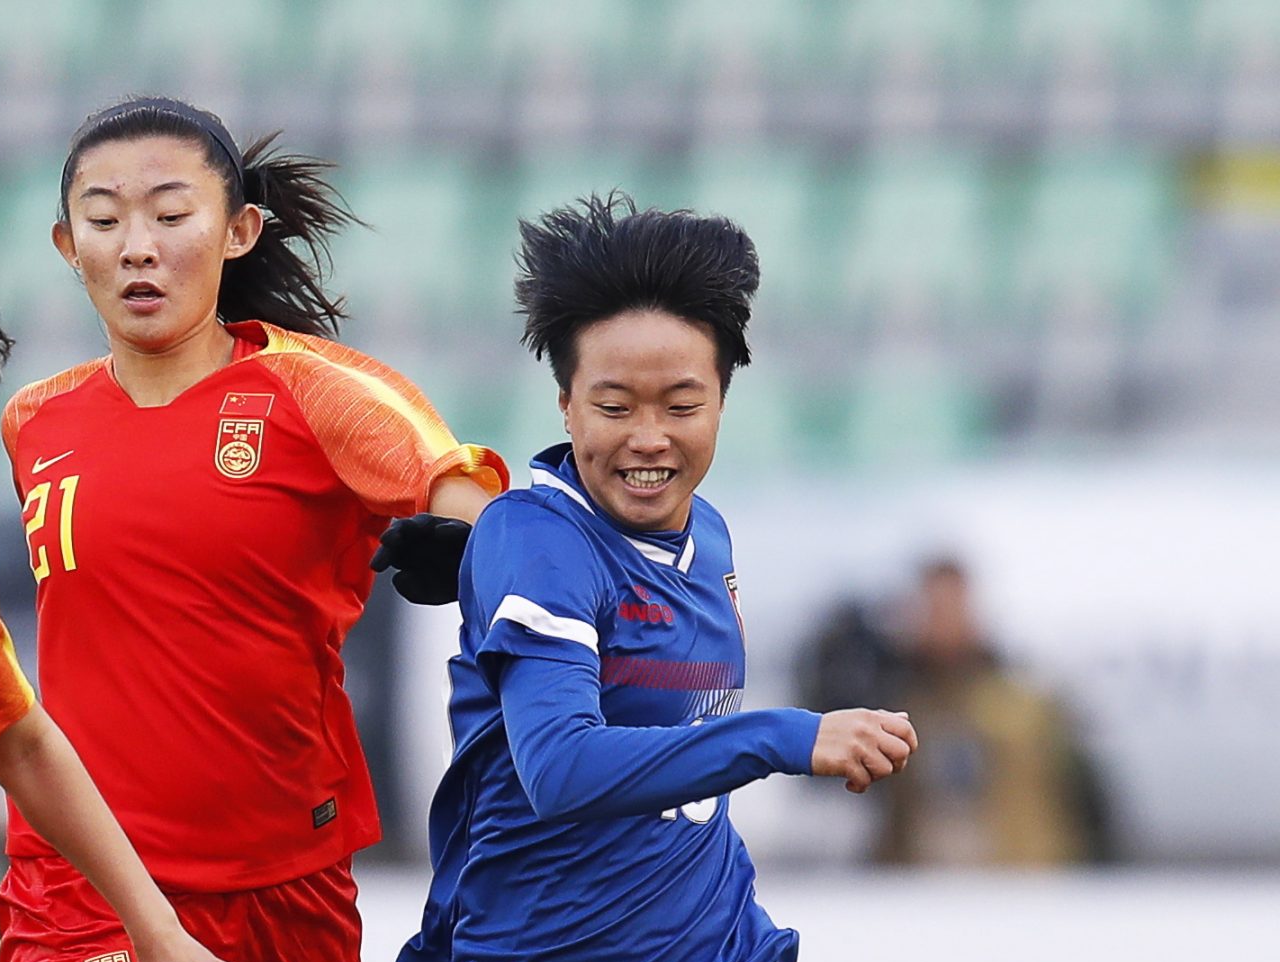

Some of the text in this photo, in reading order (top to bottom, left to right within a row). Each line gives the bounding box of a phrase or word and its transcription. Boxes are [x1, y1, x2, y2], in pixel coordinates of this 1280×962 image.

[222, 422, 260, 435] CFA
[22, 474, 80, 585] 21
[619, 601, 673, 623] ANGO
